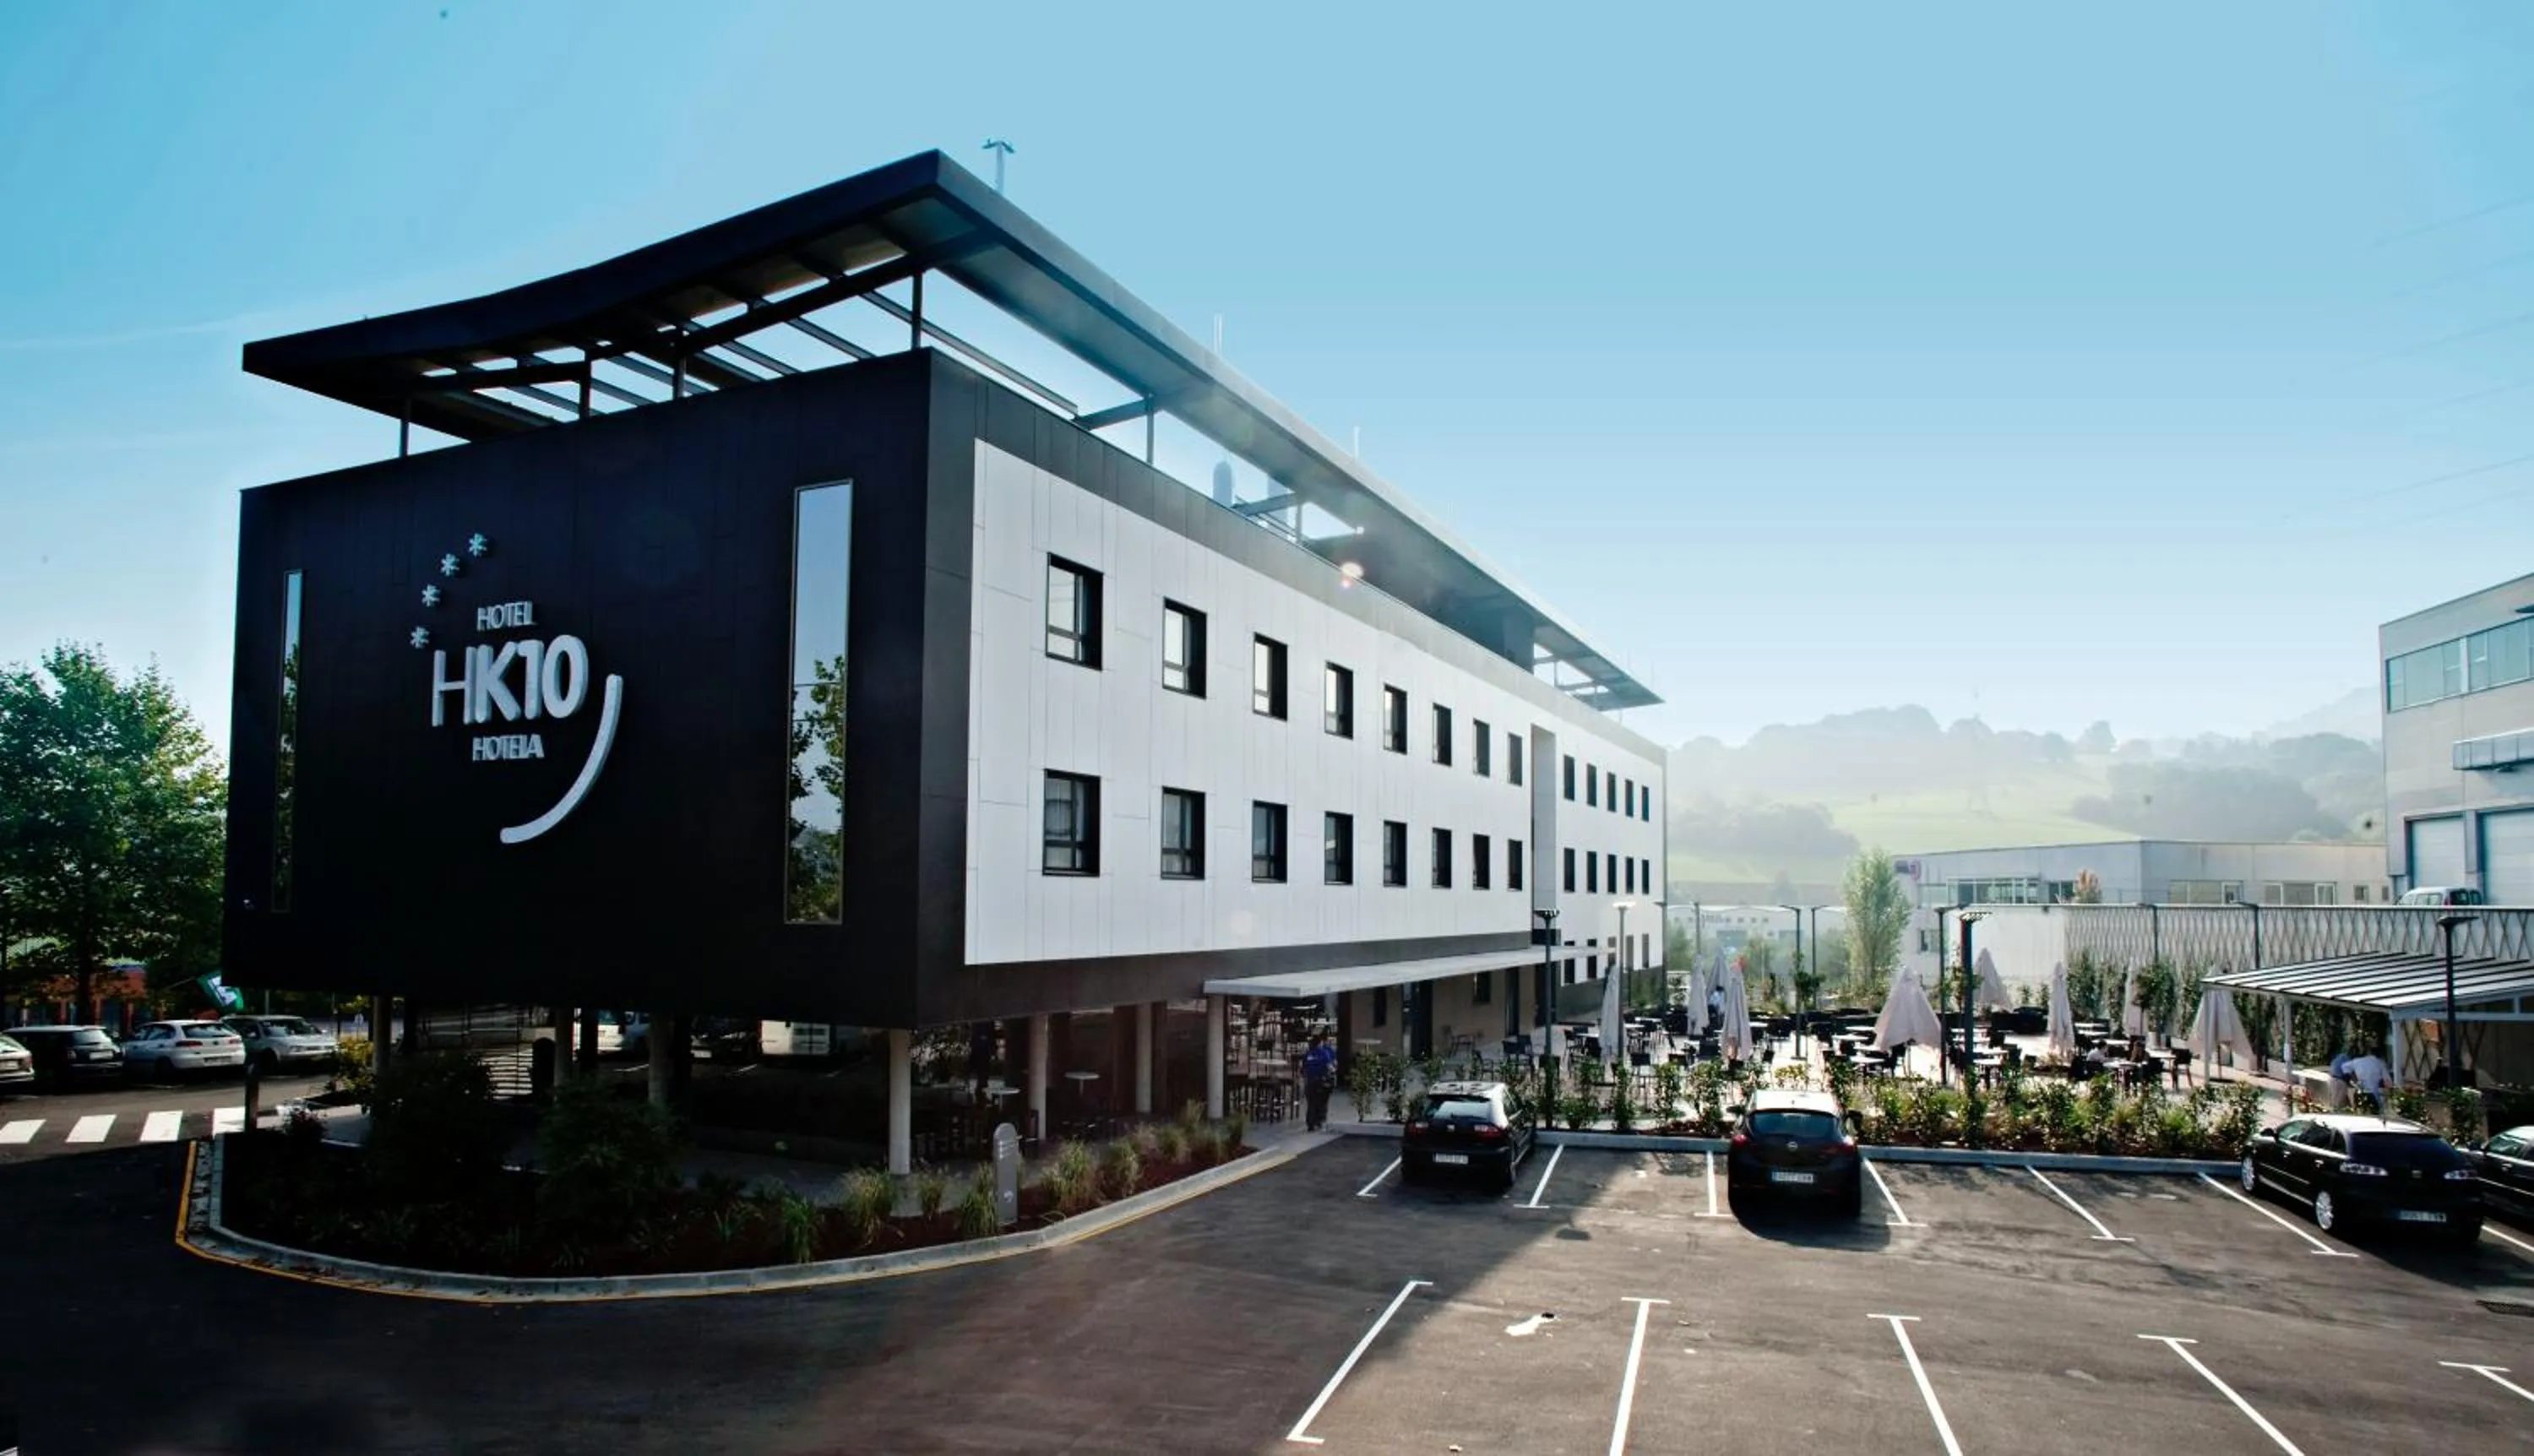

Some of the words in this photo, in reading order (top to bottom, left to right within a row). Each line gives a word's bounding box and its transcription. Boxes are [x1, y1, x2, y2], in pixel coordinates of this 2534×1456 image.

[476, 600, 535, 631] HOTEL
[432, 634, 589, 726] HK10
[472, 733, 545, 762] HOTELA
